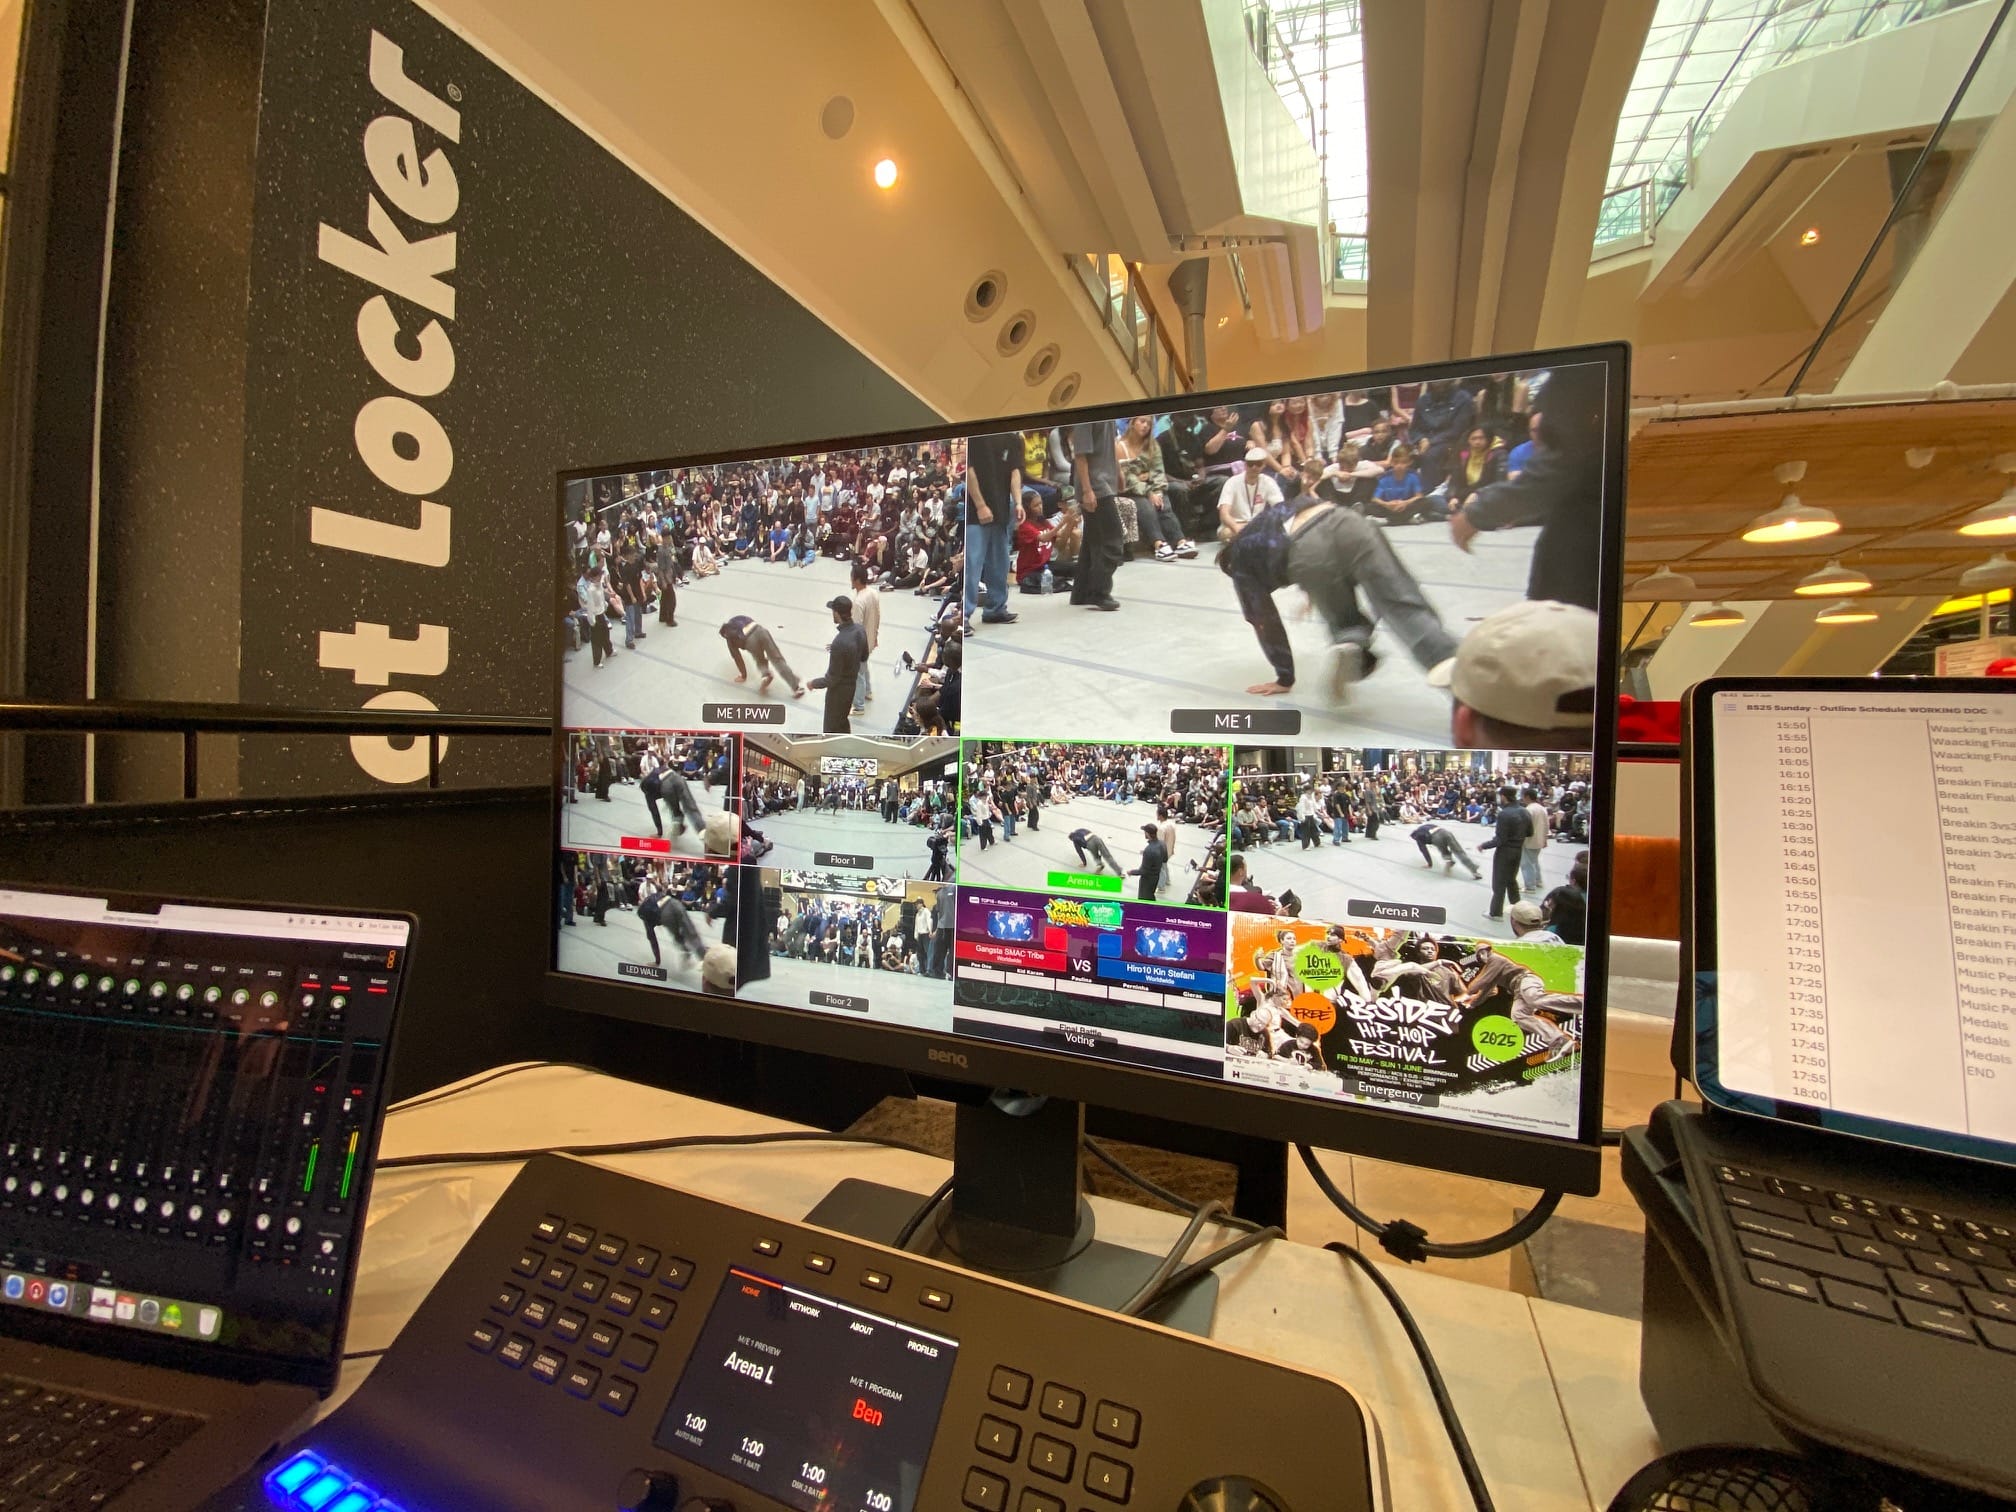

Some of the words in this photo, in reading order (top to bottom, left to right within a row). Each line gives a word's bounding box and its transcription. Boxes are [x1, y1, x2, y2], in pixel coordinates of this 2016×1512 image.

[311, 27, 461, 568] Locker
[716, 707, 734, 719] ME
[736, 708, 741, 719] 1
[745, 708, 770, 720] PVW
[1774, 704, 1811, 713] Sunday
[1820, 705, 1856, 713] Outline
[1858, 706, 1906, 714] Schedule
[1908, 707, 1961, 715] WORKING
[1963, 707, 1988, 715] DOC
[1214, 714, 1241, 729] ME
[1245, 714, 1252, 729] 1
[1777, 721, 1807, 730] 15:50
[1930, 725, 1987, 735] Waacking
[1777, 733, 1808, 742] 15:55
[1932, 738, 1989, 749] Waacking
[1778, 746, 1808, 754] 16:00
[1779, 758, 1809, 767] 16:05
[1934, 751, 1992, 762] Waacking
[1779, 770, 1810, 779] 16:10
[1936, 764, 1964, 773] Host
[1780, 783, 1811, 792] 16:15
[1937, 777, 1981, 787] Breakin
[1781, 795, 1812, 805] 16:20
[1939, 791, 1983, 800] Breakin
[1781, 808, 1812, 818] 16:25
[1941, 805, 1969, 814] Host
[1782, 821, 1813, 831] 16:30
[1942, 818, 1987, 828] Breakin
[1783, 835, 1814, 845] 16:35
[1944, 832, 1989, 843] Breakin
[1783, 848, 1815, 858] 16:40
[1945, 847, 1991, 857] Breakin
[830, 856, 850, 865] Floor
[1947, 862, 1976, 871] Host
[1784, 862, 1816, 872] 16:45
[1067, 875, 1094, 887] Arena
[1785, 875, 1817, 886] 16:50
[1949, 875, 1995, 887] Breakin
[1785, 889, 1818, 900] 16:55
[1950, 890, 1996, 902] Breakin
[1372, 904, 1408, 918] Arena
[1412, 906, 1420, 919] R
[1786, 903, 1818, 914] 17:00
[1952, 905, 1998, 917] Breakin
[1786, 918, 1819, 929] 17:05
[1954, 920, 2000, 933] Breakin
[1787, 932, 1820, 944] 17:10
[1955, 936, 2002, 948] Breakin
[976, 945, 1003, 956] Gangsta
[1005, 948, 1026, 957] SMAC
[1027, 951, 1044, 960] Tribe
[1788, 947, 1821, 958] 17:15
[1956, 951, 2003, 965] Breakin
[1073, 958, 1092, 972] VS
[1306, 954, 1331, 969] 10TH
[625, 965, 638, 975] LED
[639, 967, 659, 978] WALL
[1127, 964, 1152, 974] Hiro10
[1153, 967, 1166, 976] Kin
[1168, 969, 1195, 980] Stefani
[1788, 962, 1822, 974] 17:20
[1958, 967, 1996, 980] Music
[1789, 976, 1823, 988] 17:25
[1960, 983, 1998, 996] Music
[826, 995, 844, 1005] Floor
[846, 998, 852, 1007] 2
[1790, 992, 1823, 1004] 17:30
[1961, 999, 1999, 1013] Music
[1790, 1007, 1824, 1020] 17:35
[1791, 1022, 1825, 1035] 17:40
[1962, 1016, 2009, 1030] Medals
[1065, 1032, 1095, 1047] Voting
[1480, 1030, 1517, 1048] 2025
[1791, 1038, 1825, 1051] 17:45
[1964, 1032, 2010, 1047] Medals
[1792, 1054, 1826, 1068] 17:50
[1965, 1049, 2012, 1064] Medals
[1337, 1053, 1348, 1061] FRI
[1359, 1057, 1375, 1065] MAY
[1380, 1060, 1396, 1068] SUN
[1402, 1063, 1422, 1073] JUNE
[1792, 1070, 1827, 1084] 17:55
[1966, 1066, 1995, 1079] END
[1358, 1081, 1423, 1103] Emergency
[1793, 1086, 1827, 1101] 18:00
[741, 1285, 761, 1298] HOME
[610, 1292, 632, 1305] STINGER
[651, 1306, 661, 1316] DIP
[789, 1301, 820, 1318] NETWORK
[850, 1322, 874, 1336] ABOUT
[592, 1332, 610, 1344] COLOR
[754, 1340, 782, 1357] PREVIEW
[907, 1340, 939, 1358] PROFILES
[724, 1351, 765, 1380] Arena
[765, 1365, 774, 1385] L
[571, 1374, 589, 1387] AUDIO
[850, 1376, 864, 1388] M/E
[869, 1382, 903, 1402] PROGRAM
[1006, 1382, 1011, 1392] 1
[608, 1389, 621, 1401] AUX
[1058, 1400, 1064, 1409] 2
[853, 1398, 884, 1427] Ben
[685, 1412, 707, 1432] 1:00
[1112, 1418, 1118, 1428] 3
[993, 1433, 999, 1443] 4
[741, 1436, 764, 1457] 1:00
[1047, 1453, 1053, 1462] 5
[801, 1461, 825, 1483] 1:00
[1104, 1474, 1110, 1483] 6
[981, 1487, 987, 1497] 7
[865, 1489, 891, 1512] 1:00
